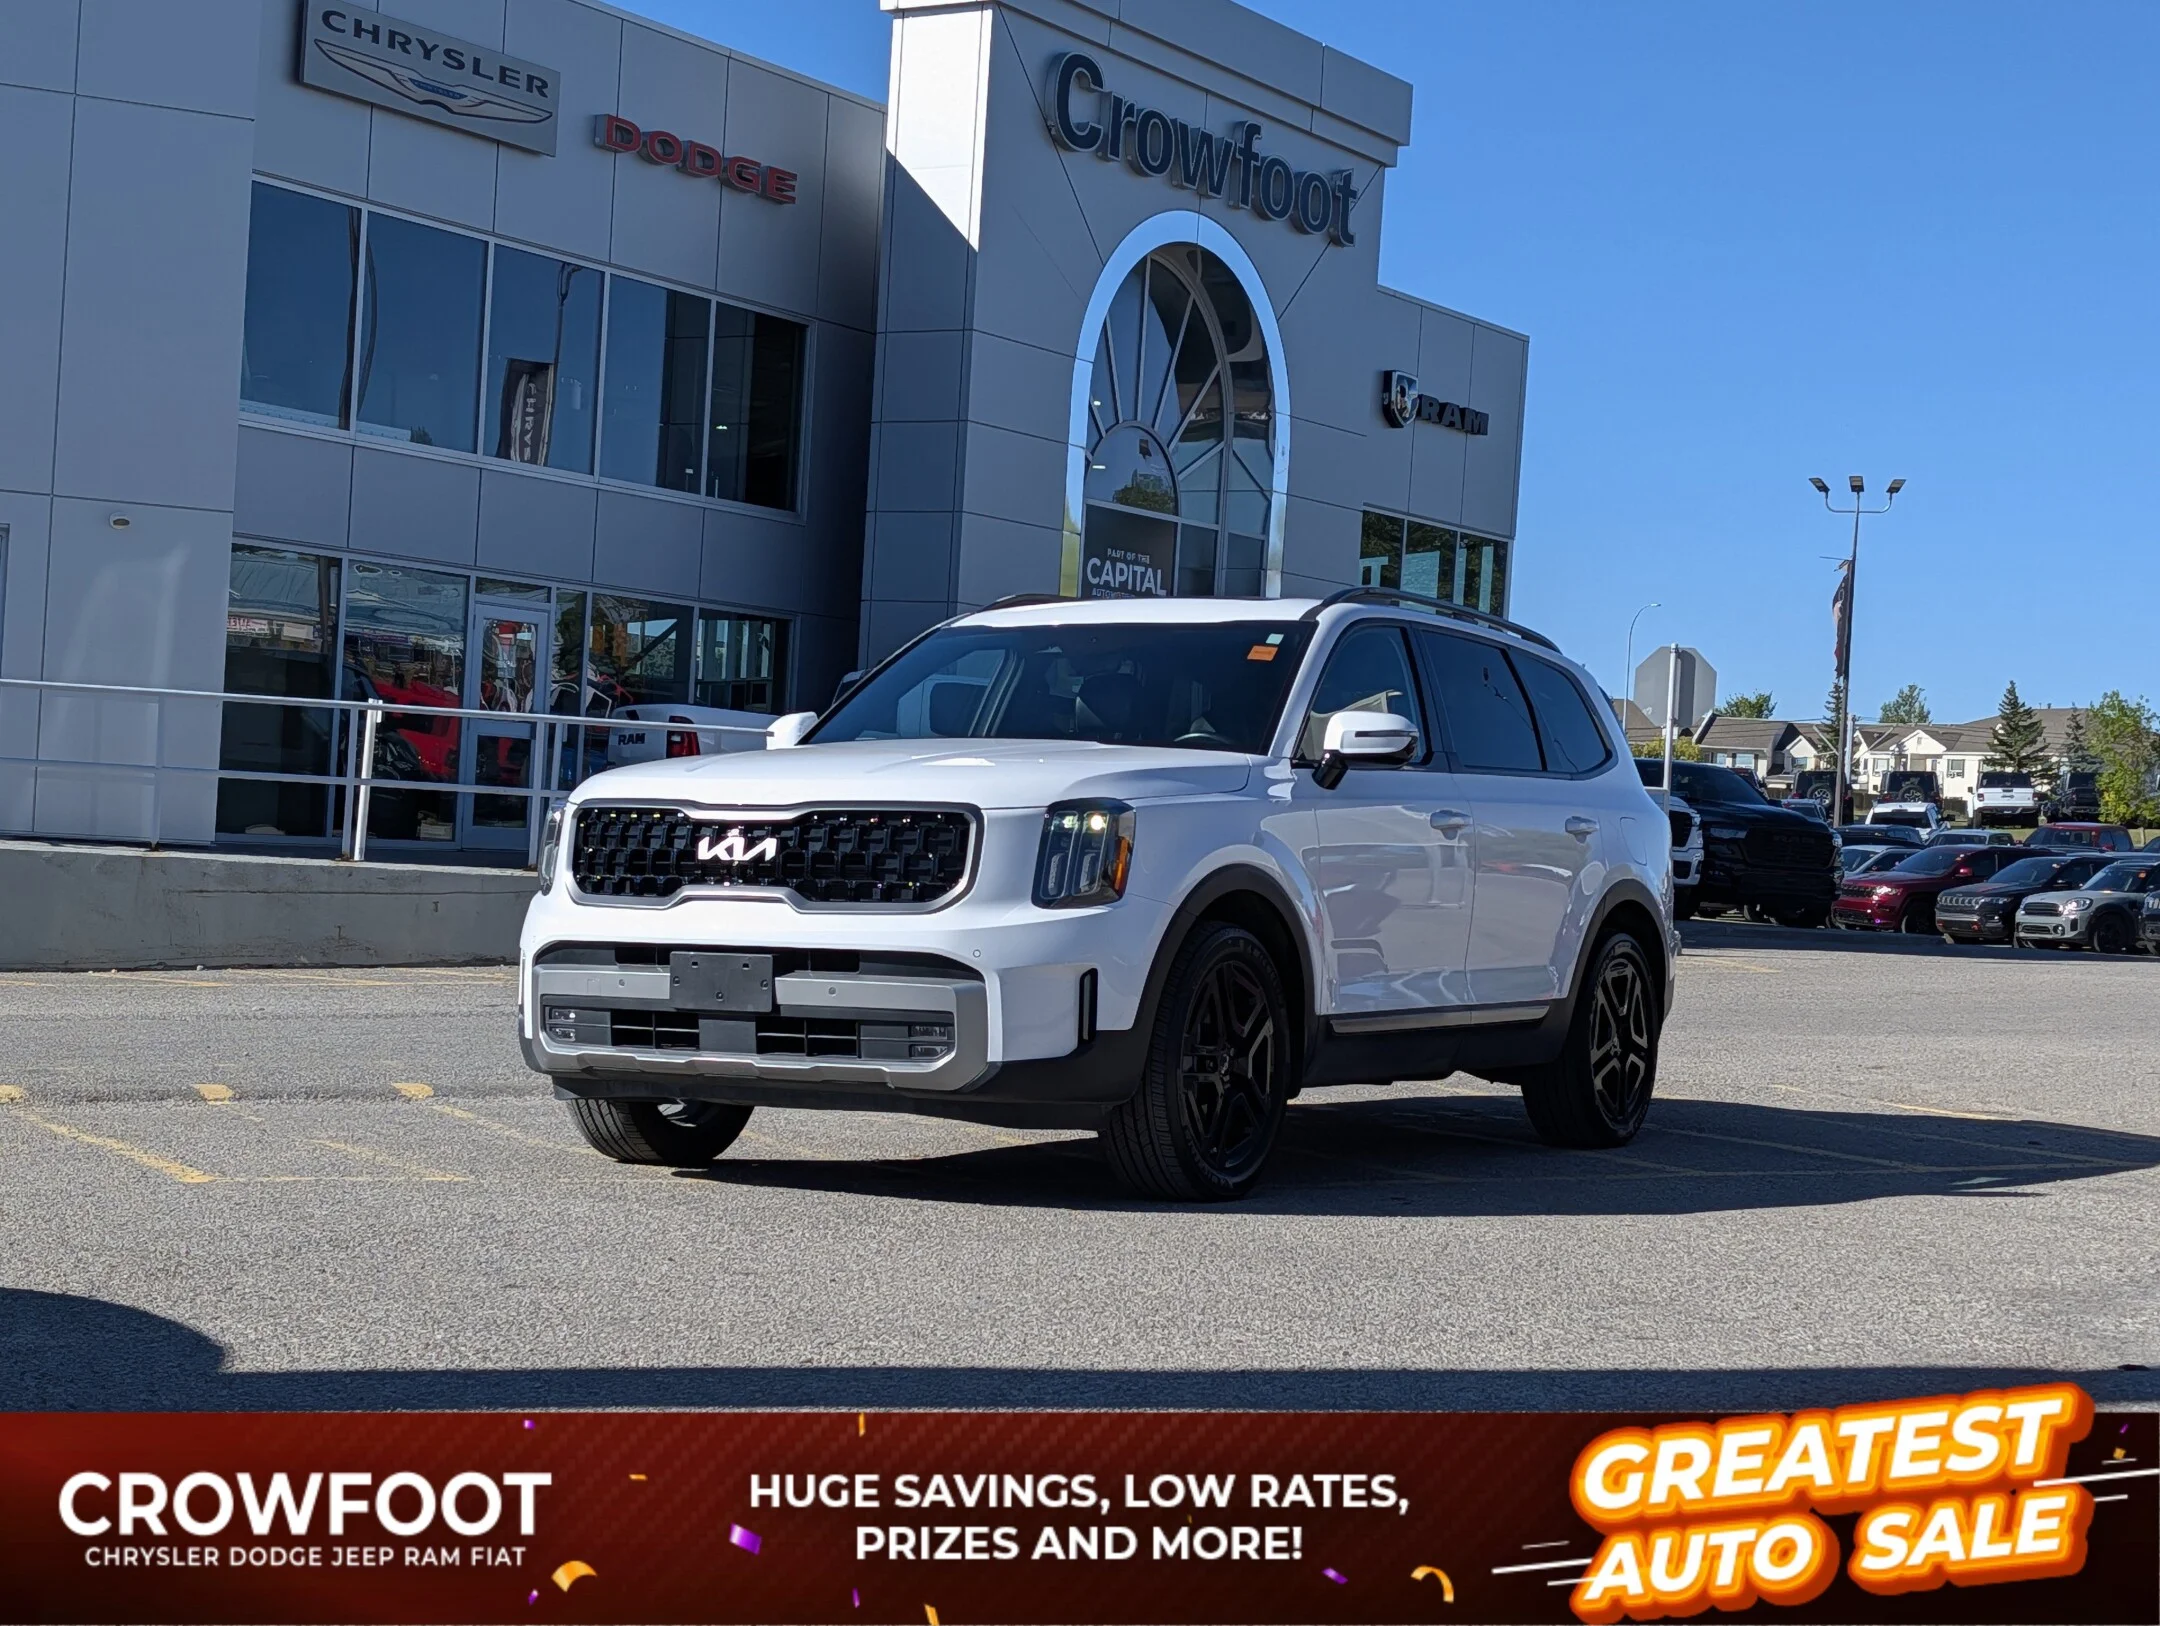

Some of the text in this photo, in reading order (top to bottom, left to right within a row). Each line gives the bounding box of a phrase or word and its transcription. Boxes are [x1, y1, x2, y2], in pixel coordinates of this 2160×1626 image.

[321, 10, 549, 98] CHRYSLER
[596, 114, 798, 204] DODGE
[1049, 52, 1358, 247] Crowfoot
[1418, 394, 1490, 436] RAM
[1107, 547, 1125, 560] PART
[1126, 551, 1136, 561] OF
[1087, 557, 1167, 597] CAPITAL
[618, 732, 646, 746] RAM
[697, 836, 778, 862] KIA
